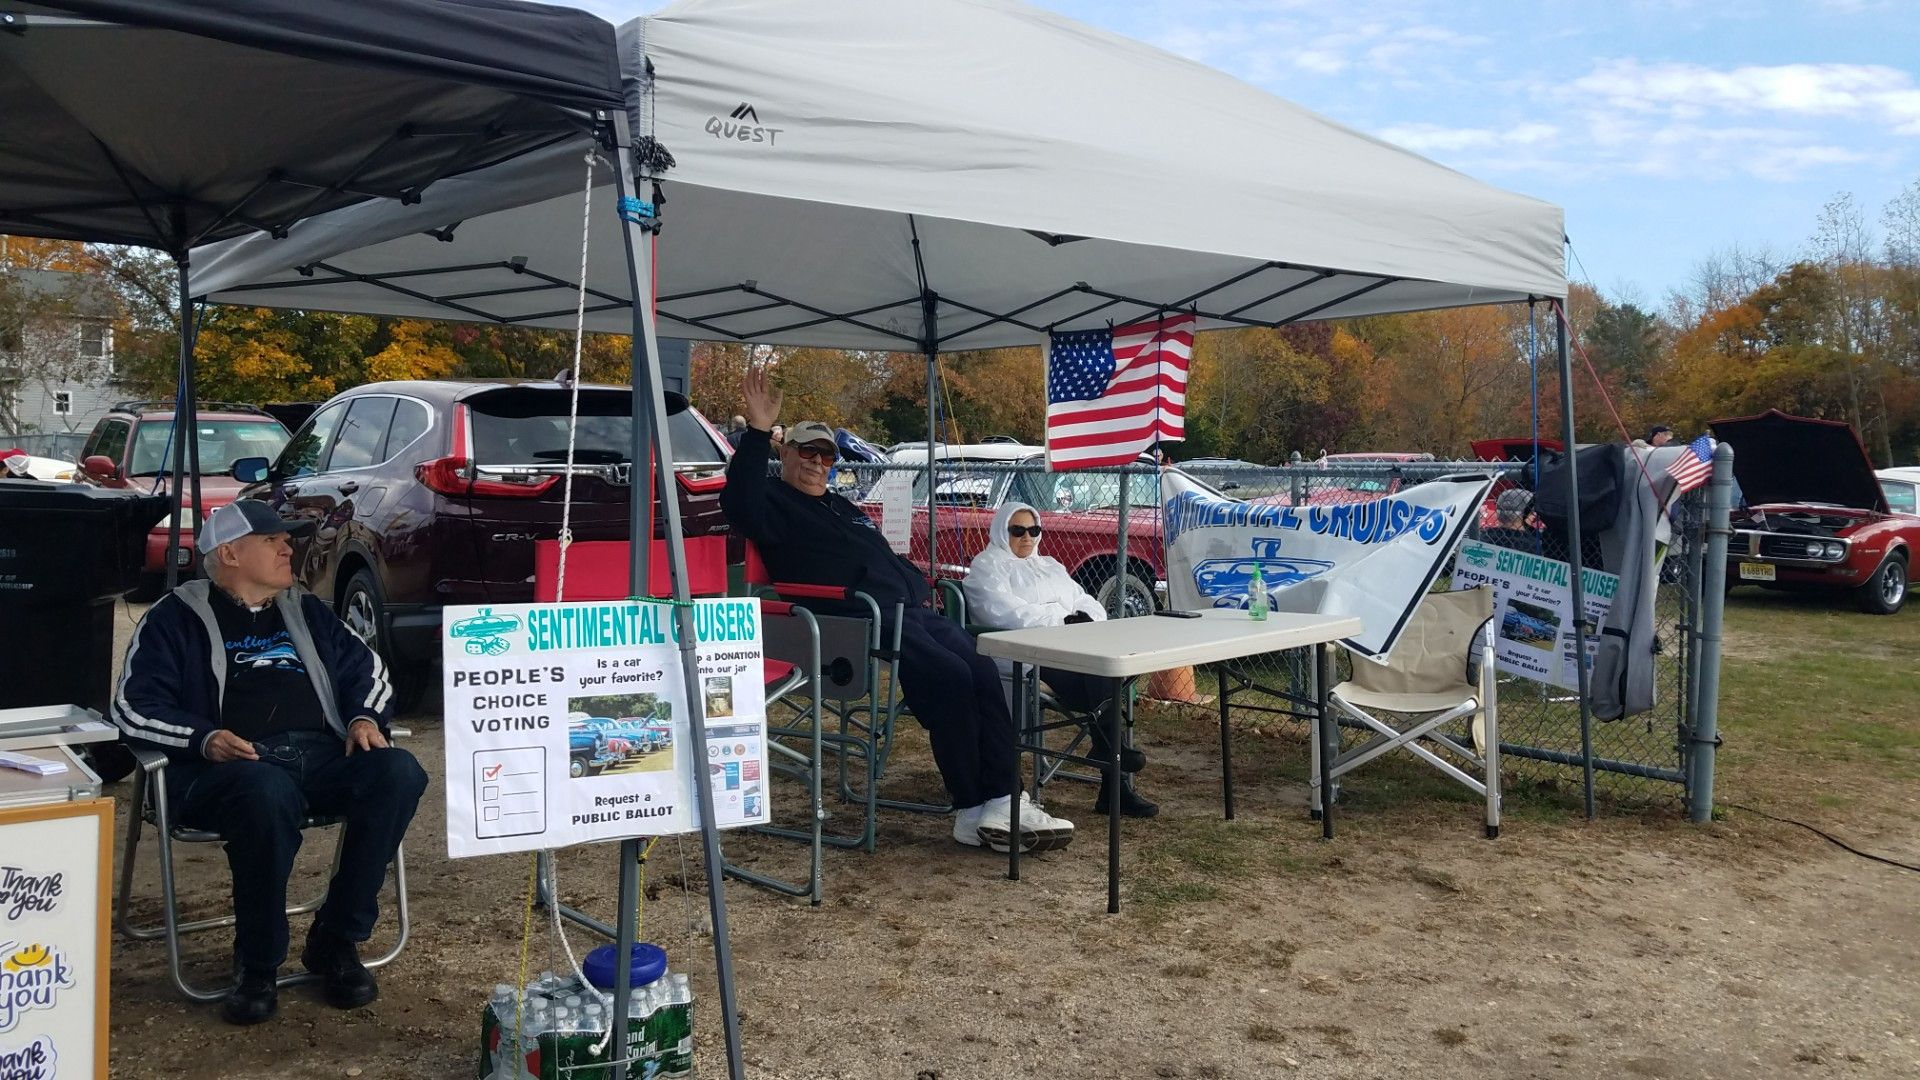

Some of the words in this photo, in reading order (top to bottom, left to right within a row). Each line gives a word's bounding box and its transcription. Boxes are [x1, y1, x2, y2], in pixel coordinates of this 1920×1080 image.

[705, 116, 784, 146] QUEST
[491, 533, 540, 542] CR-V
[1496, 550, 1568, 587] SENTIMENTAL
[1457, 569, 1511, 589] PEOPLE'S
[528, 606, 665, 651] SENTIMENTAL
[597, 658, 608, 669] Is
[612, 660, 619, 668] a
[623, 657, 641, 668] car
[706, 654, 712, 662] a
[715, 651, 761, 661] DONATION
[453, 667, 565, 687] PEOPLE'S
[717, 665, 731, 674] our
[734, 664, 747, 675] jar
[1522, 662, 1548, 675] BALLOT
[579, 674, 608, 689] your
[611, 671, 663, 685] favorite?
[473, 693, 548, 710] CHOICE
[471, 716, 550, 733] VOTING
[595, 793, 640, 807] Request
[644, 794, 651, 802] a
[572, 811, 621, 825] PUBLIC
[626, 806, 673, 819] BALLOT
[1, 867, 62, 897] Thank
[8, 891, 57, 921] you
[0, 953, 69, 990] hank
